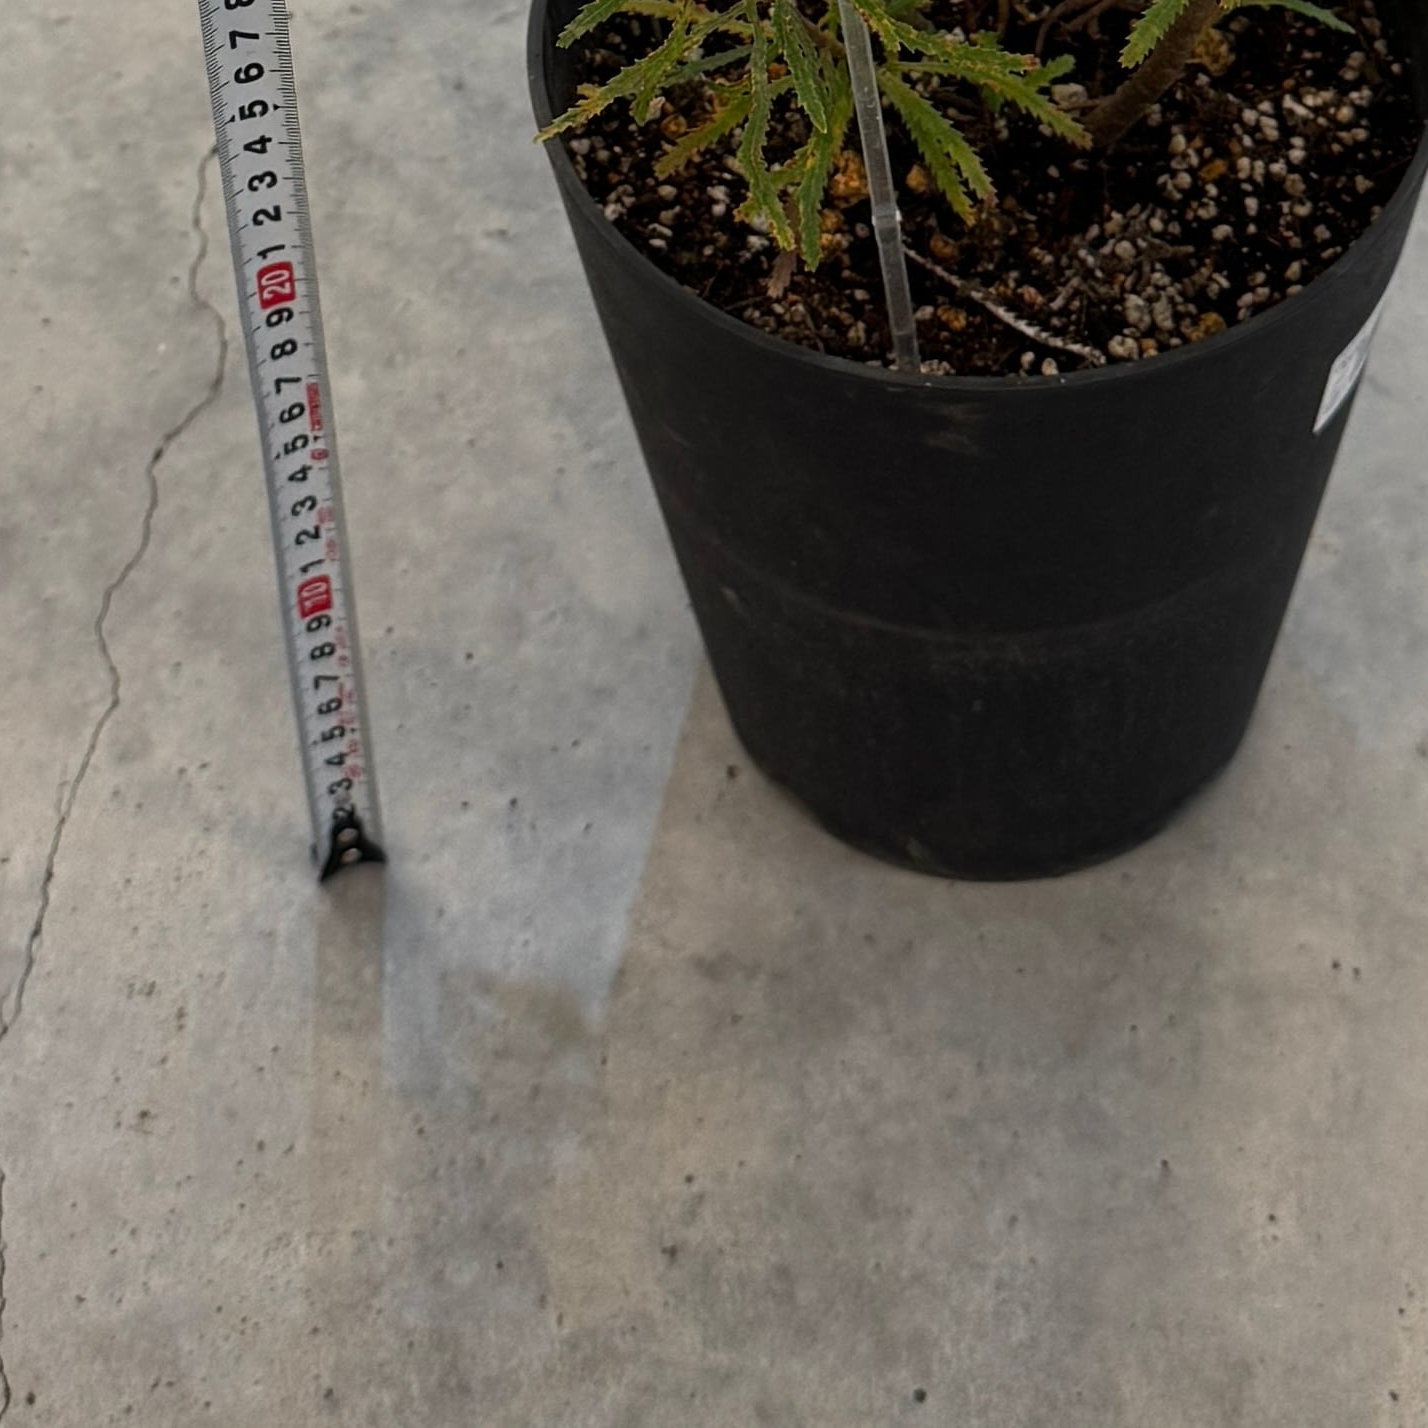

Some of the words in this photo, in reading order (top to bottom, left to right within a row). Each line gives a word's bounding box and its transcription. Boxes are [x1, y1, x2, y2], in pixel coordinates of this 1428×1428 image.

[229, 31, 259, 49] 7
[234, 63, 264, 83] 6
[239, 100, 268, 120] 5
[244, 135, 272, 154] 4
[248, 171, 277, 192] 3
[252, 205, 281, 226] 2
[257, 244, 285, 259] 1
[261, 270, 291, 299] 20
[266, 307, 293, 327] 9
[270, 339, 297, 360] 8
[275, 377, 302, 394] 7
[279, 403, 305, 424] 6
[284, 434, 309, 455] 5
[288, 465, 312, 482] 4
[291, 496, 317, 516] 3
[295, 525, 321, 545] 2
[299, 559, 325, 574] 1
[306, 614, 332, 633] 9
[310, 642, 336, 661] 8
[313, 675, 340, 691] 7
